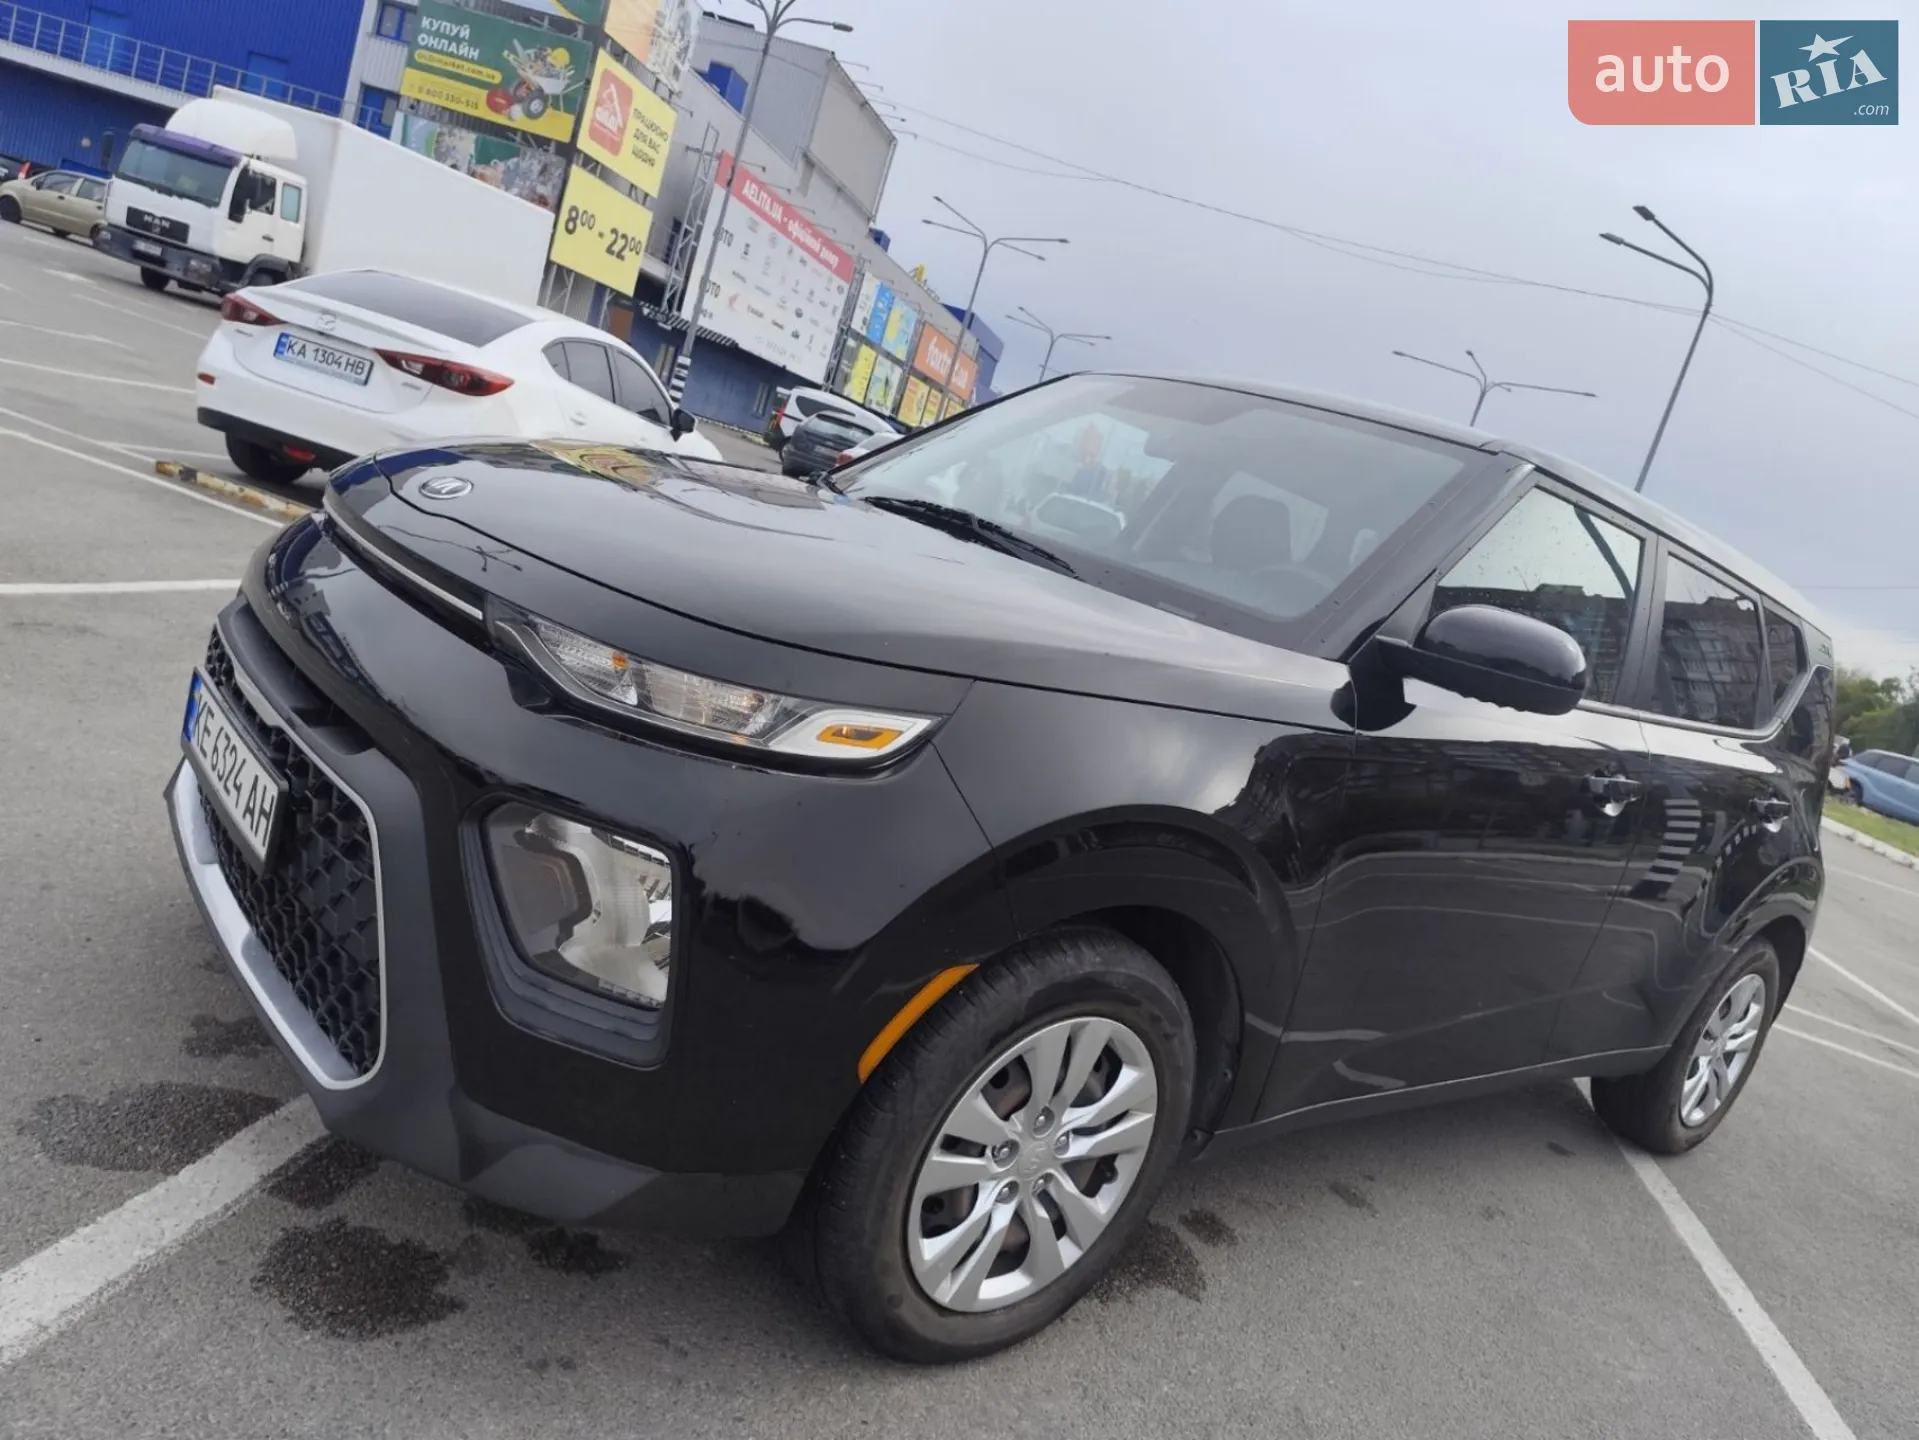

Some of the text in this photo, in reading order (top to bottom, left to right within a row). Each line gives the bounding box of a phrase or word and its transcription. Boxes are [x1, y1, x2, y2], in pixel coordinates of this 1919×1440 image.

[421, 15, 470, 41] КУПУЙ
[417, 33, 480, 61] ОНЛАЙН
[144, 214, 170, 229] MAN
[286, 339, 366, 376] KA 1304 HB
[210, 726, 248, 809] 6324
[242, 773, 275, 848] AH
